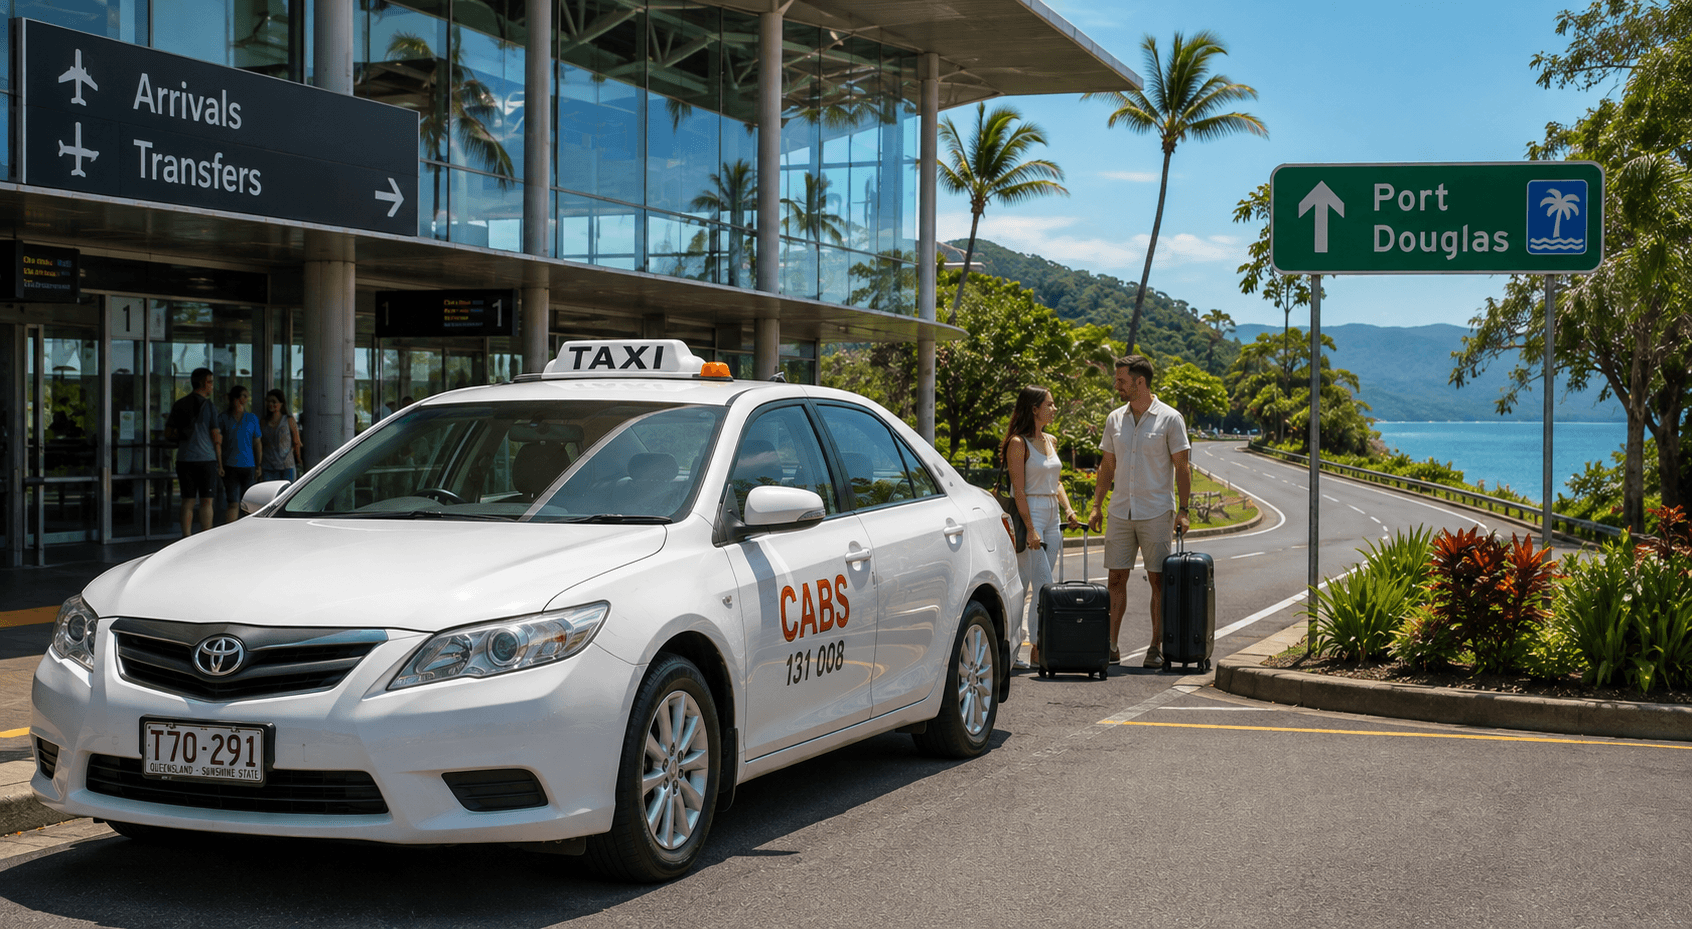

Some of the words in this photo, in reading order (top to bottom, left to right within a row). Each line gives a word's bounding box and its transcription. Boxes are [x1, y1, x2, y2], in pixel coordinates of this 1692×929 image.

[133, 73, 242, 130] Arrivals
[133, 139, 262, 196] Transfers
[1374, 183, 1448, 211] Port
[1374, 224, 1509, 260] Douglas
[123, 305, 131, 332] 1
[492, 299, 502, 327] 1
[569, 346, 664, 370] TAXI
[780, 574, 850, 642] CABS
[786, 649, 811, 686] 131
[816, 640, 844, 677] 008
[150, 729, 256, 767] T70-291
[238, 769, 259, 779] STATE
